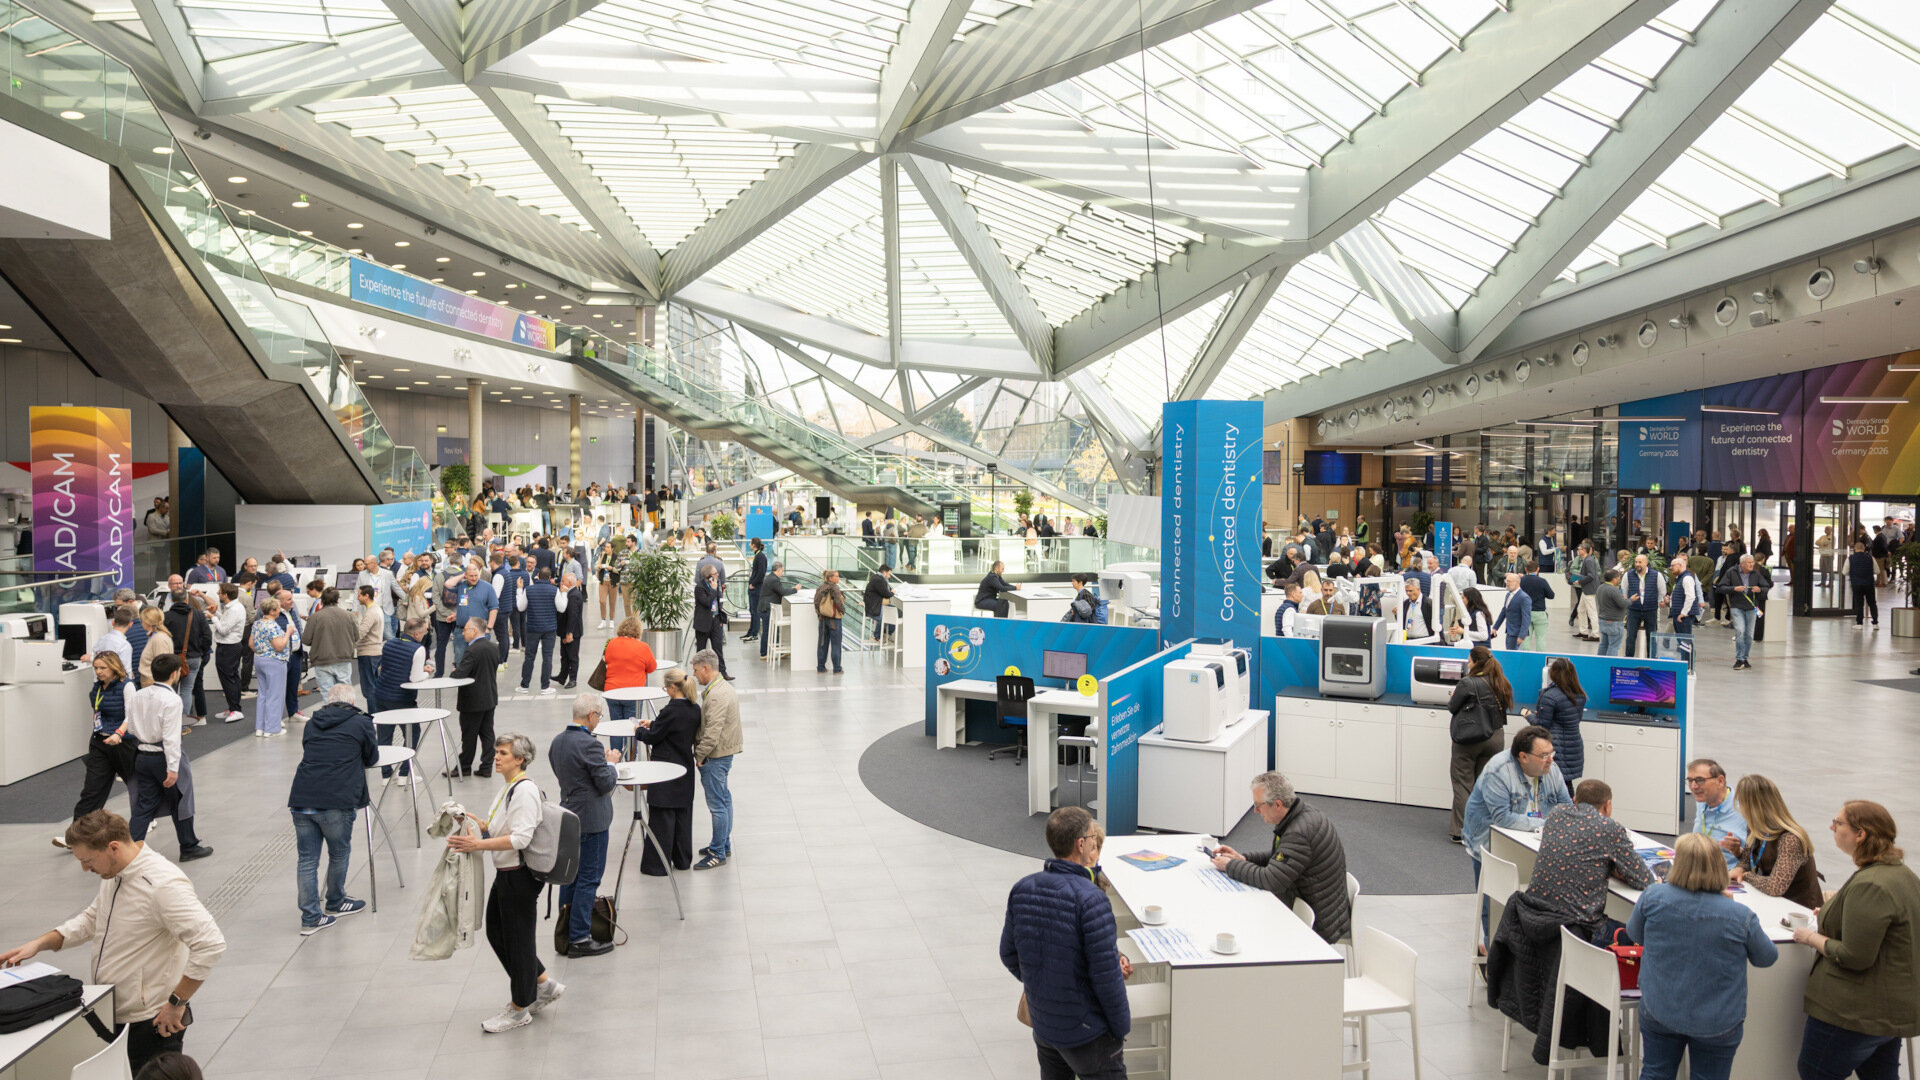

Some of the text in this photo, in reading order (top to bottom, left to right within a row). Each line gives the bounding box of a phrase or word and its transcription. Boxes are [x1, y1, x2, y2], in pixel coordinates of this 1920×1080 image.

[359, 273, 503, 331] Experience the future of connected dentistry
[527, 330, 547, 345] WORLD
[1720, 421, 1782, 434] Experience the
[1846, 424, 1890, 436] WORLD
[1649, 431, 1680, 440] WORLD
[1711, 433, 1793, 445] future of connected
[1639, 449, 1679, 459] Germany 2026
[1731, 446, 1769, 458] dentistry
[1831, 446, 1889, 457] Germany 2026
[108, 453, 124, 586] CAD/CAM
[1172, 423, 1185, 618] Connected dentistry
[1220, 422, 1240, 622] Connected dentistry
[1111, 710, 1128, 726] Erleben
[1111, 723, 1130, 741] vernetzte
